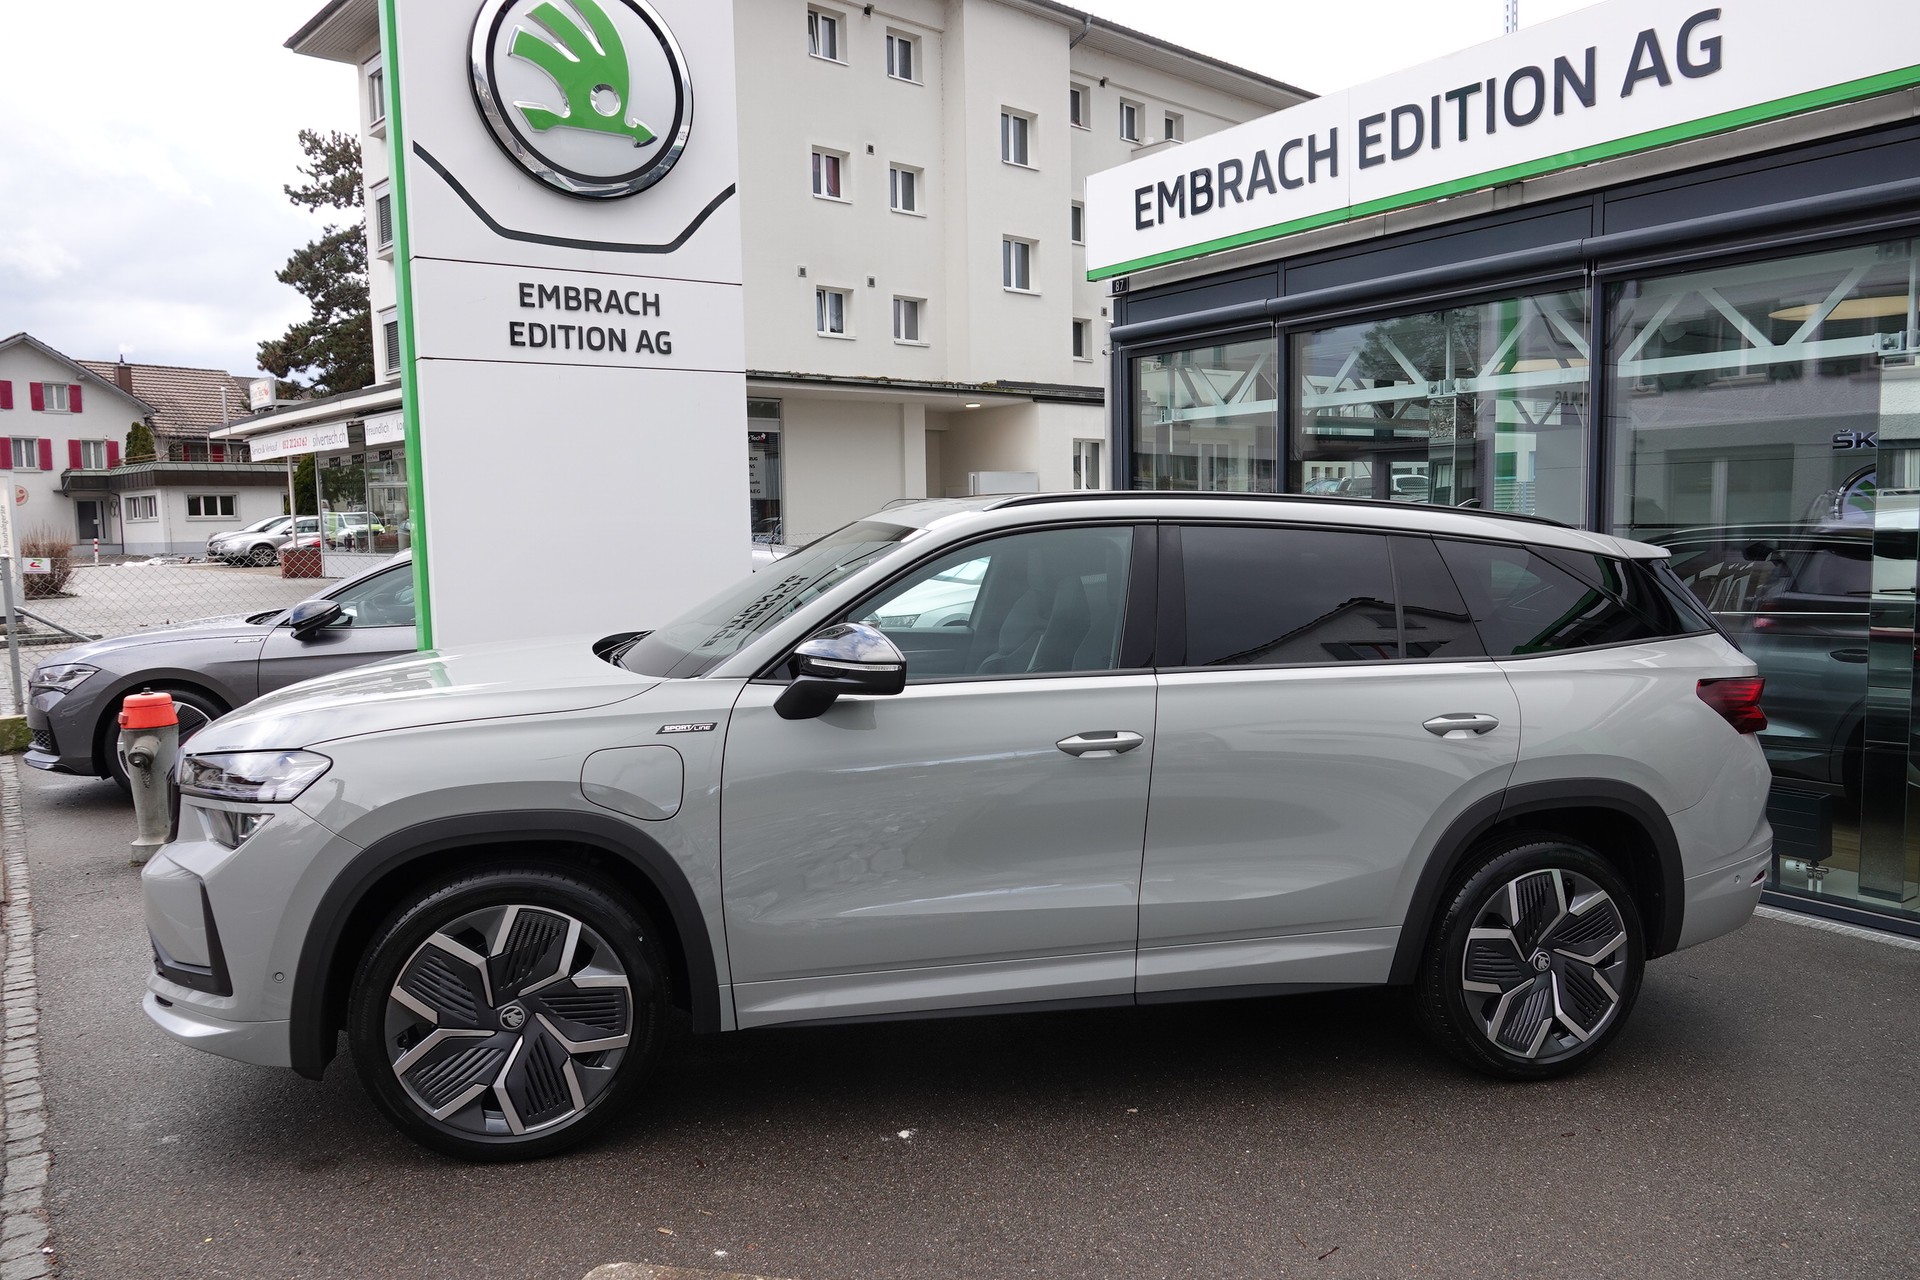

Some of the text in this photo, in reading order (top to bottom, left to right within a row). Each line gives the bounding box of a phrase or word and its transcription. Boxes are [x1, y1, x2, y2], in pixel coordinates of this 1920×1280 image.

[1134, 7, 1723, 231] EMBRACH EDITION AG
[519, 282, 661, 317] EMBRACH
[1115, 280, 1124, 292] 87
[509, 321, 672, 355] EDITION AG
[313, 427, 346, 447] silvertech.ch
[1832, 429, 1878, 449] ŠK
